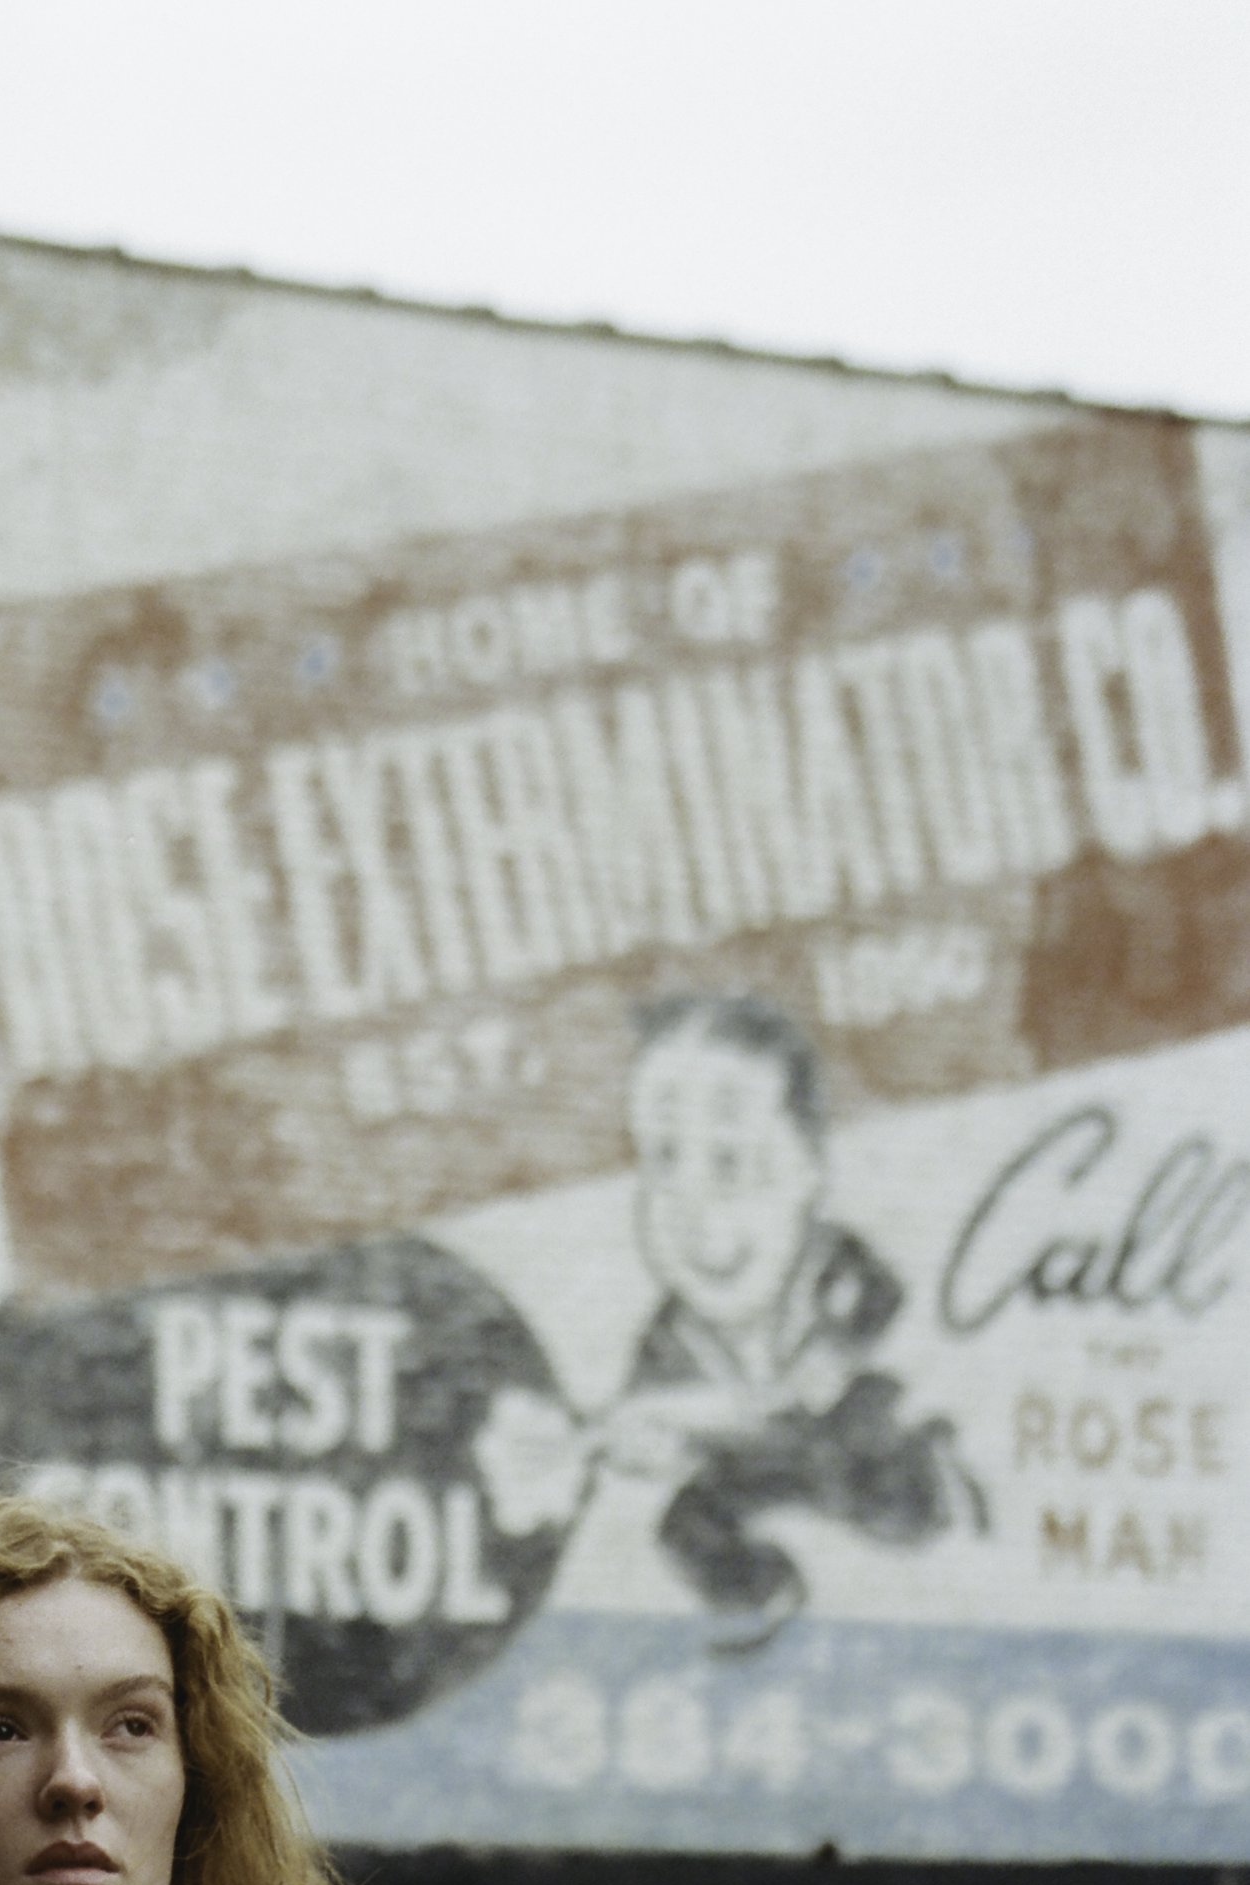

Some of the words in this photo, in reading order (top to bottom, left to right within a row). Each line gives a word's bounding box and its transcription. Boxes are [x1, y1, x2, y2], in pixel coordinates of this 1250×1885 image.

[668, 552, 782, 642] OF
[937, 1103, 1250, 1336] Call
[153, 1298, 416, 1457] PEST
[1012, 1392, 1226, 1480] ROSE
[1038, 1507, 1208, 1580] MAN
